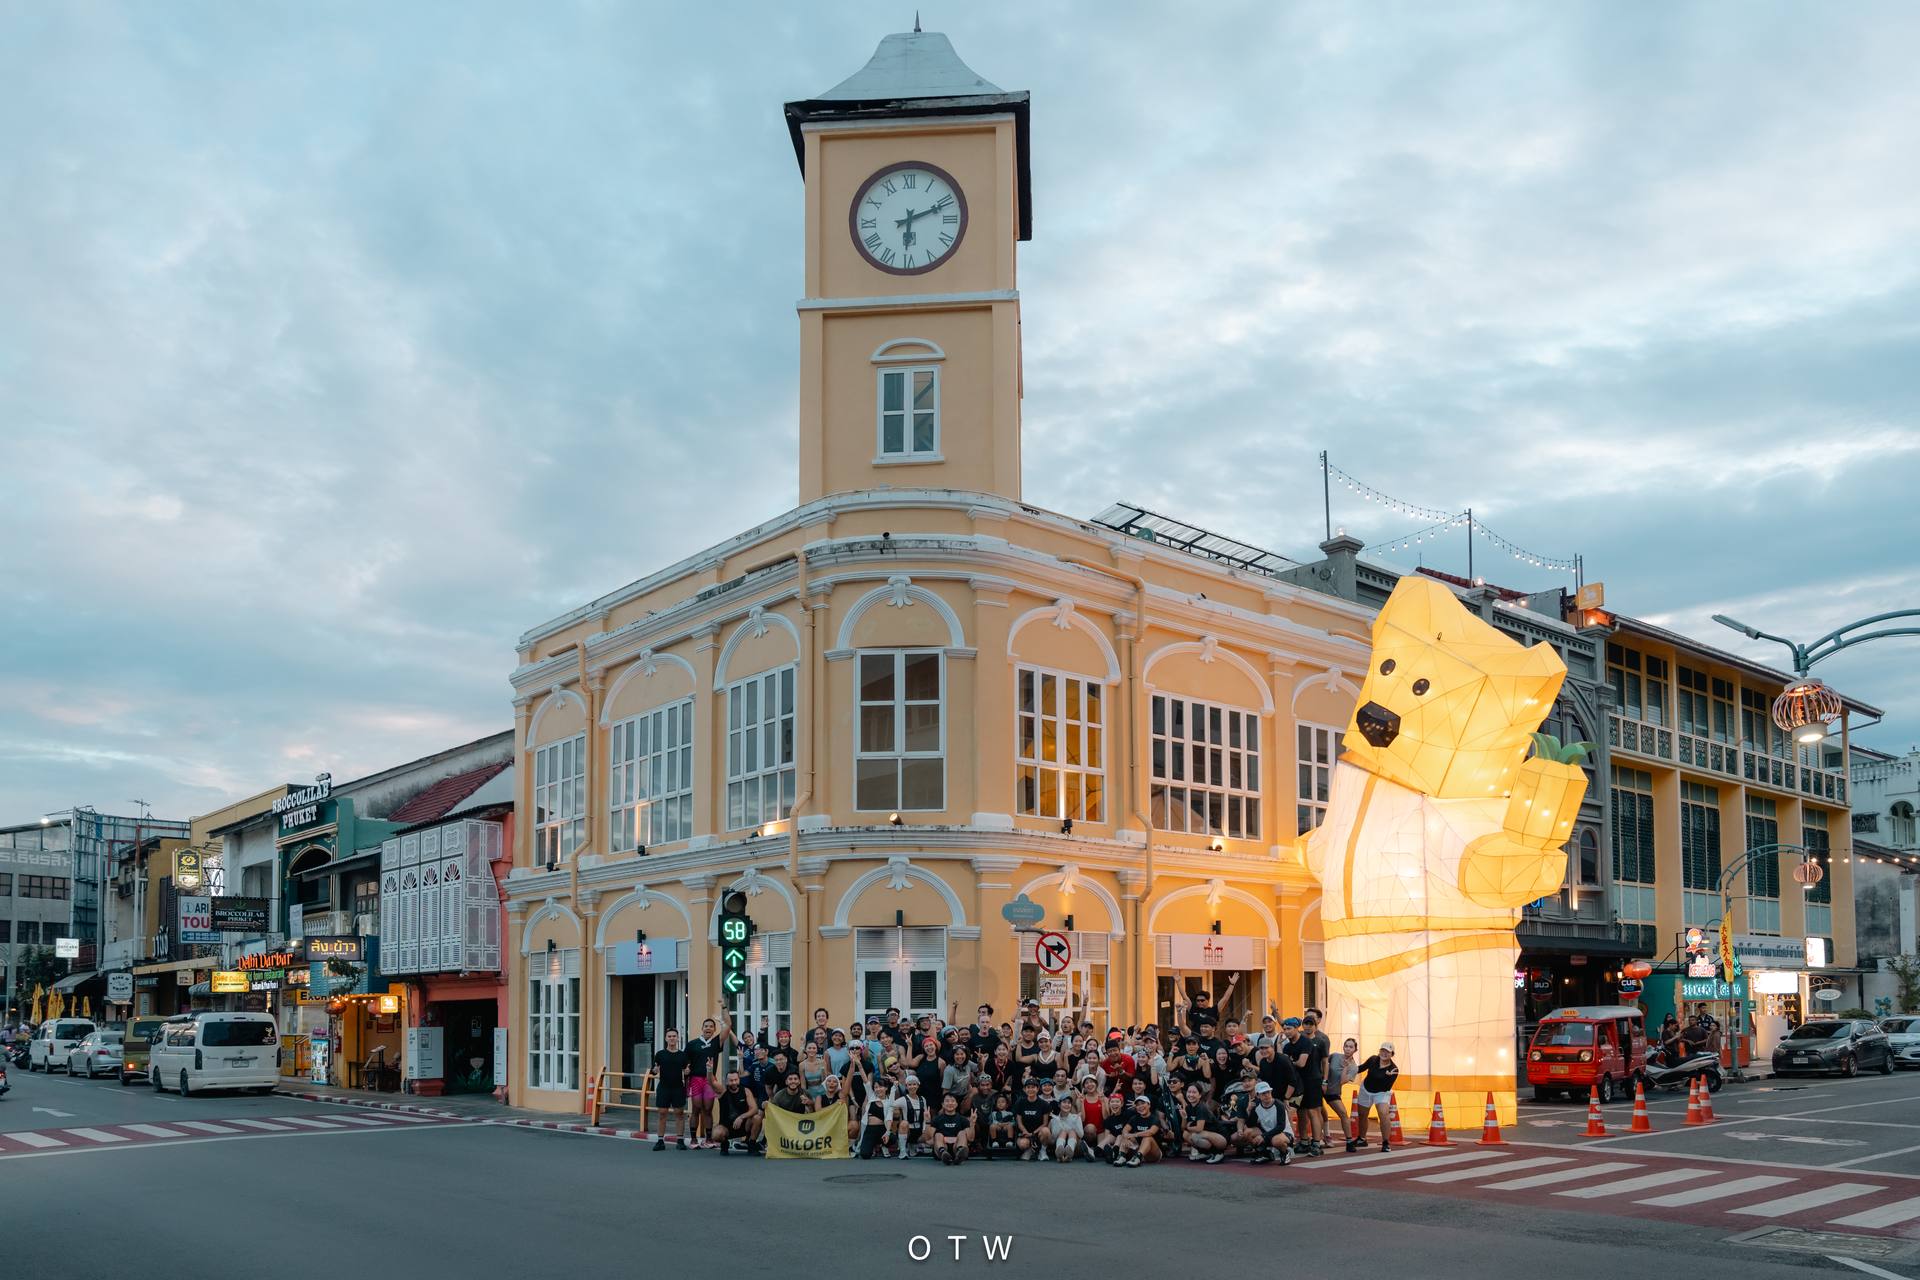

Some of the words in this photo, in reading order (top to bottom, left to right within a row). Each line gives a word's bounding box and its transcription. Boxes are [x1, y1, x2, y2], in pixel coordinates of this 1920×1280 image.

[881, 178, 897, 197] XI
[902, 174, 916, 190] XII
[925, 178, 935, 193] I
[866, 196, 882, 210] X
[861, 217, 877, 229] IX
[942, 214, 958, 225] III
[864, 232, 882, 254] VIII
[880, 247, 896, 266] VII
[903, 254, 916, 269] VI
[926, 248, 937, 263] V
[272, 782, 329, 815] BROCCOLILAB
[282, 805, 317, 829] PHUKET
[723, 921, 745, 941] 58
[238, 953, 258, 971] Delhi
[260, 952, 293, 969] Darbar
[780, 1135, 832, 1151] WILDER
